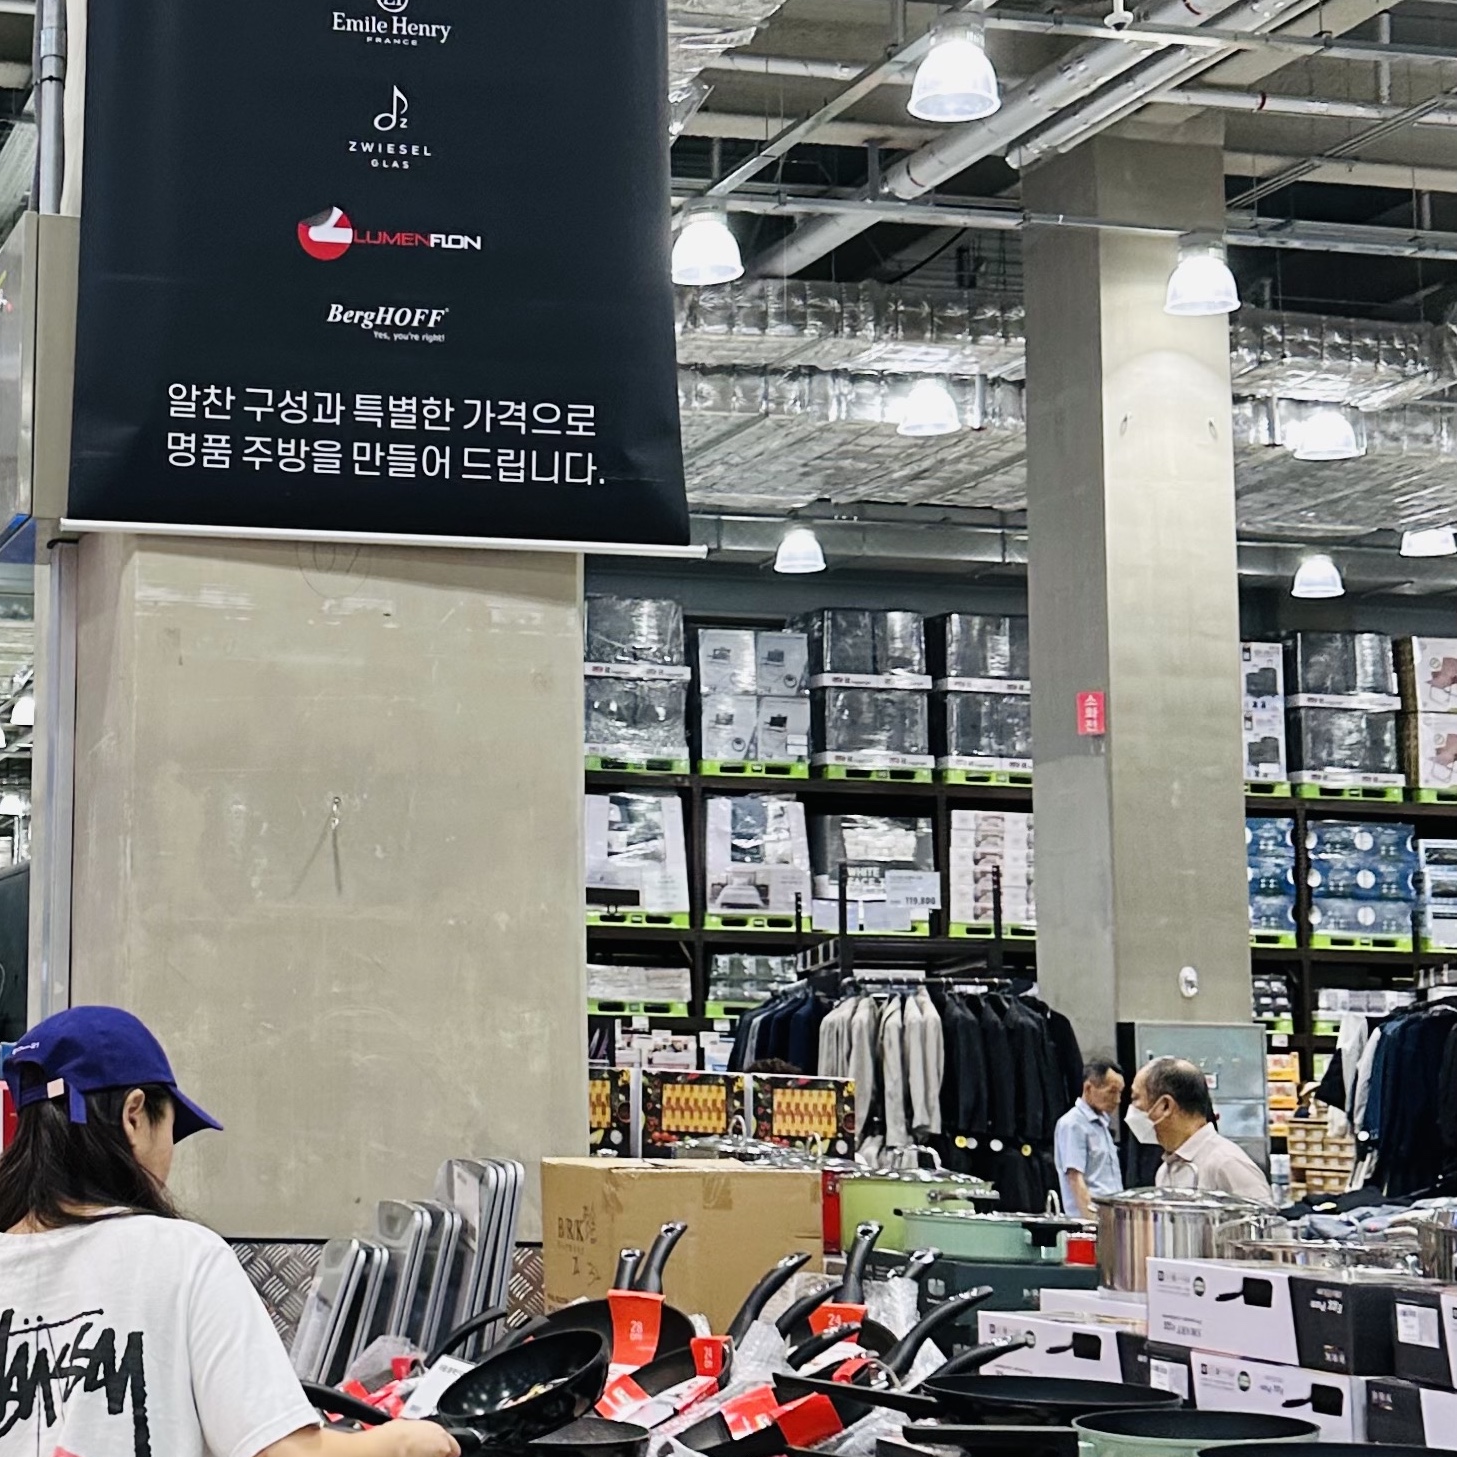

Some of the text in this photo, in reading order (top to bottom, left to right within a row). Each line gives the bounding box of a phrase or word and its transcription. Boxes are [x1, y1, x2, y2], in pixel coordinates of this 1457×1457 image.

[332, 11, 452, 43] Emile Henry
[366, 36, 418, 46] FRANCE
[348, 140, 432, 157] ZWIESEL
[370, 158, 410, 169] GLAS
[168, 382, 597, 437] 알찬 구성과 특별한 가격으로
[167, 432, 606, 486] 명품 주방을 만들어 드립니다.
[558, 1217, 584, 1242] BRK
